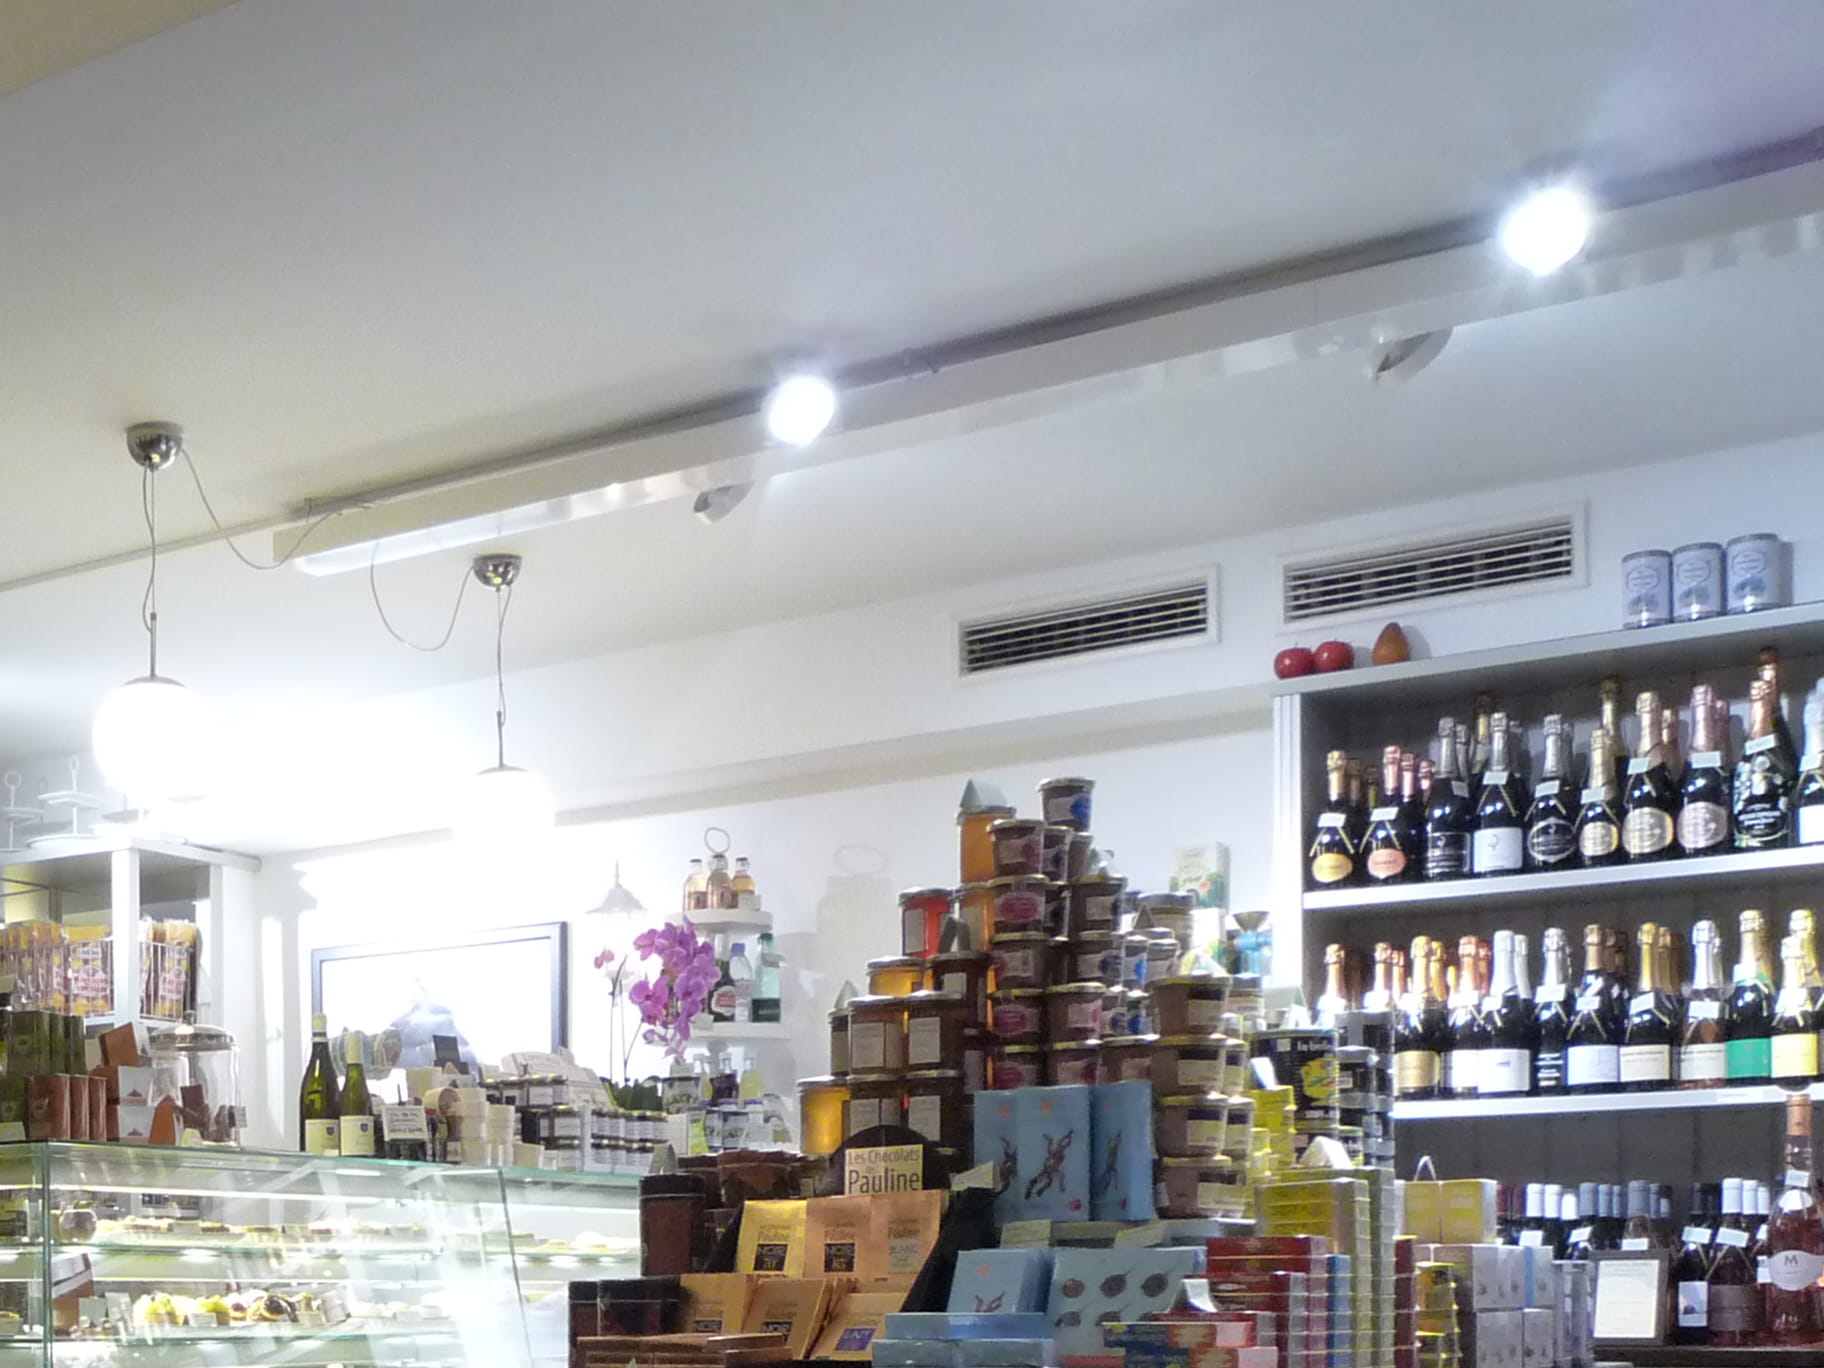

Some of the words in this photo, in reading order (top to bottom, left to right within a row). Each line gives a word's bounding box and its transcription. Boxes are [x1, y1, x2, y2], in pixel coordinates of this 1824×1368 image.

[848, 1151, 866, 1164] Les
[868, 1147, 920, 1163] Chocolats
[848, 1165, 920, 1195] Pauline
